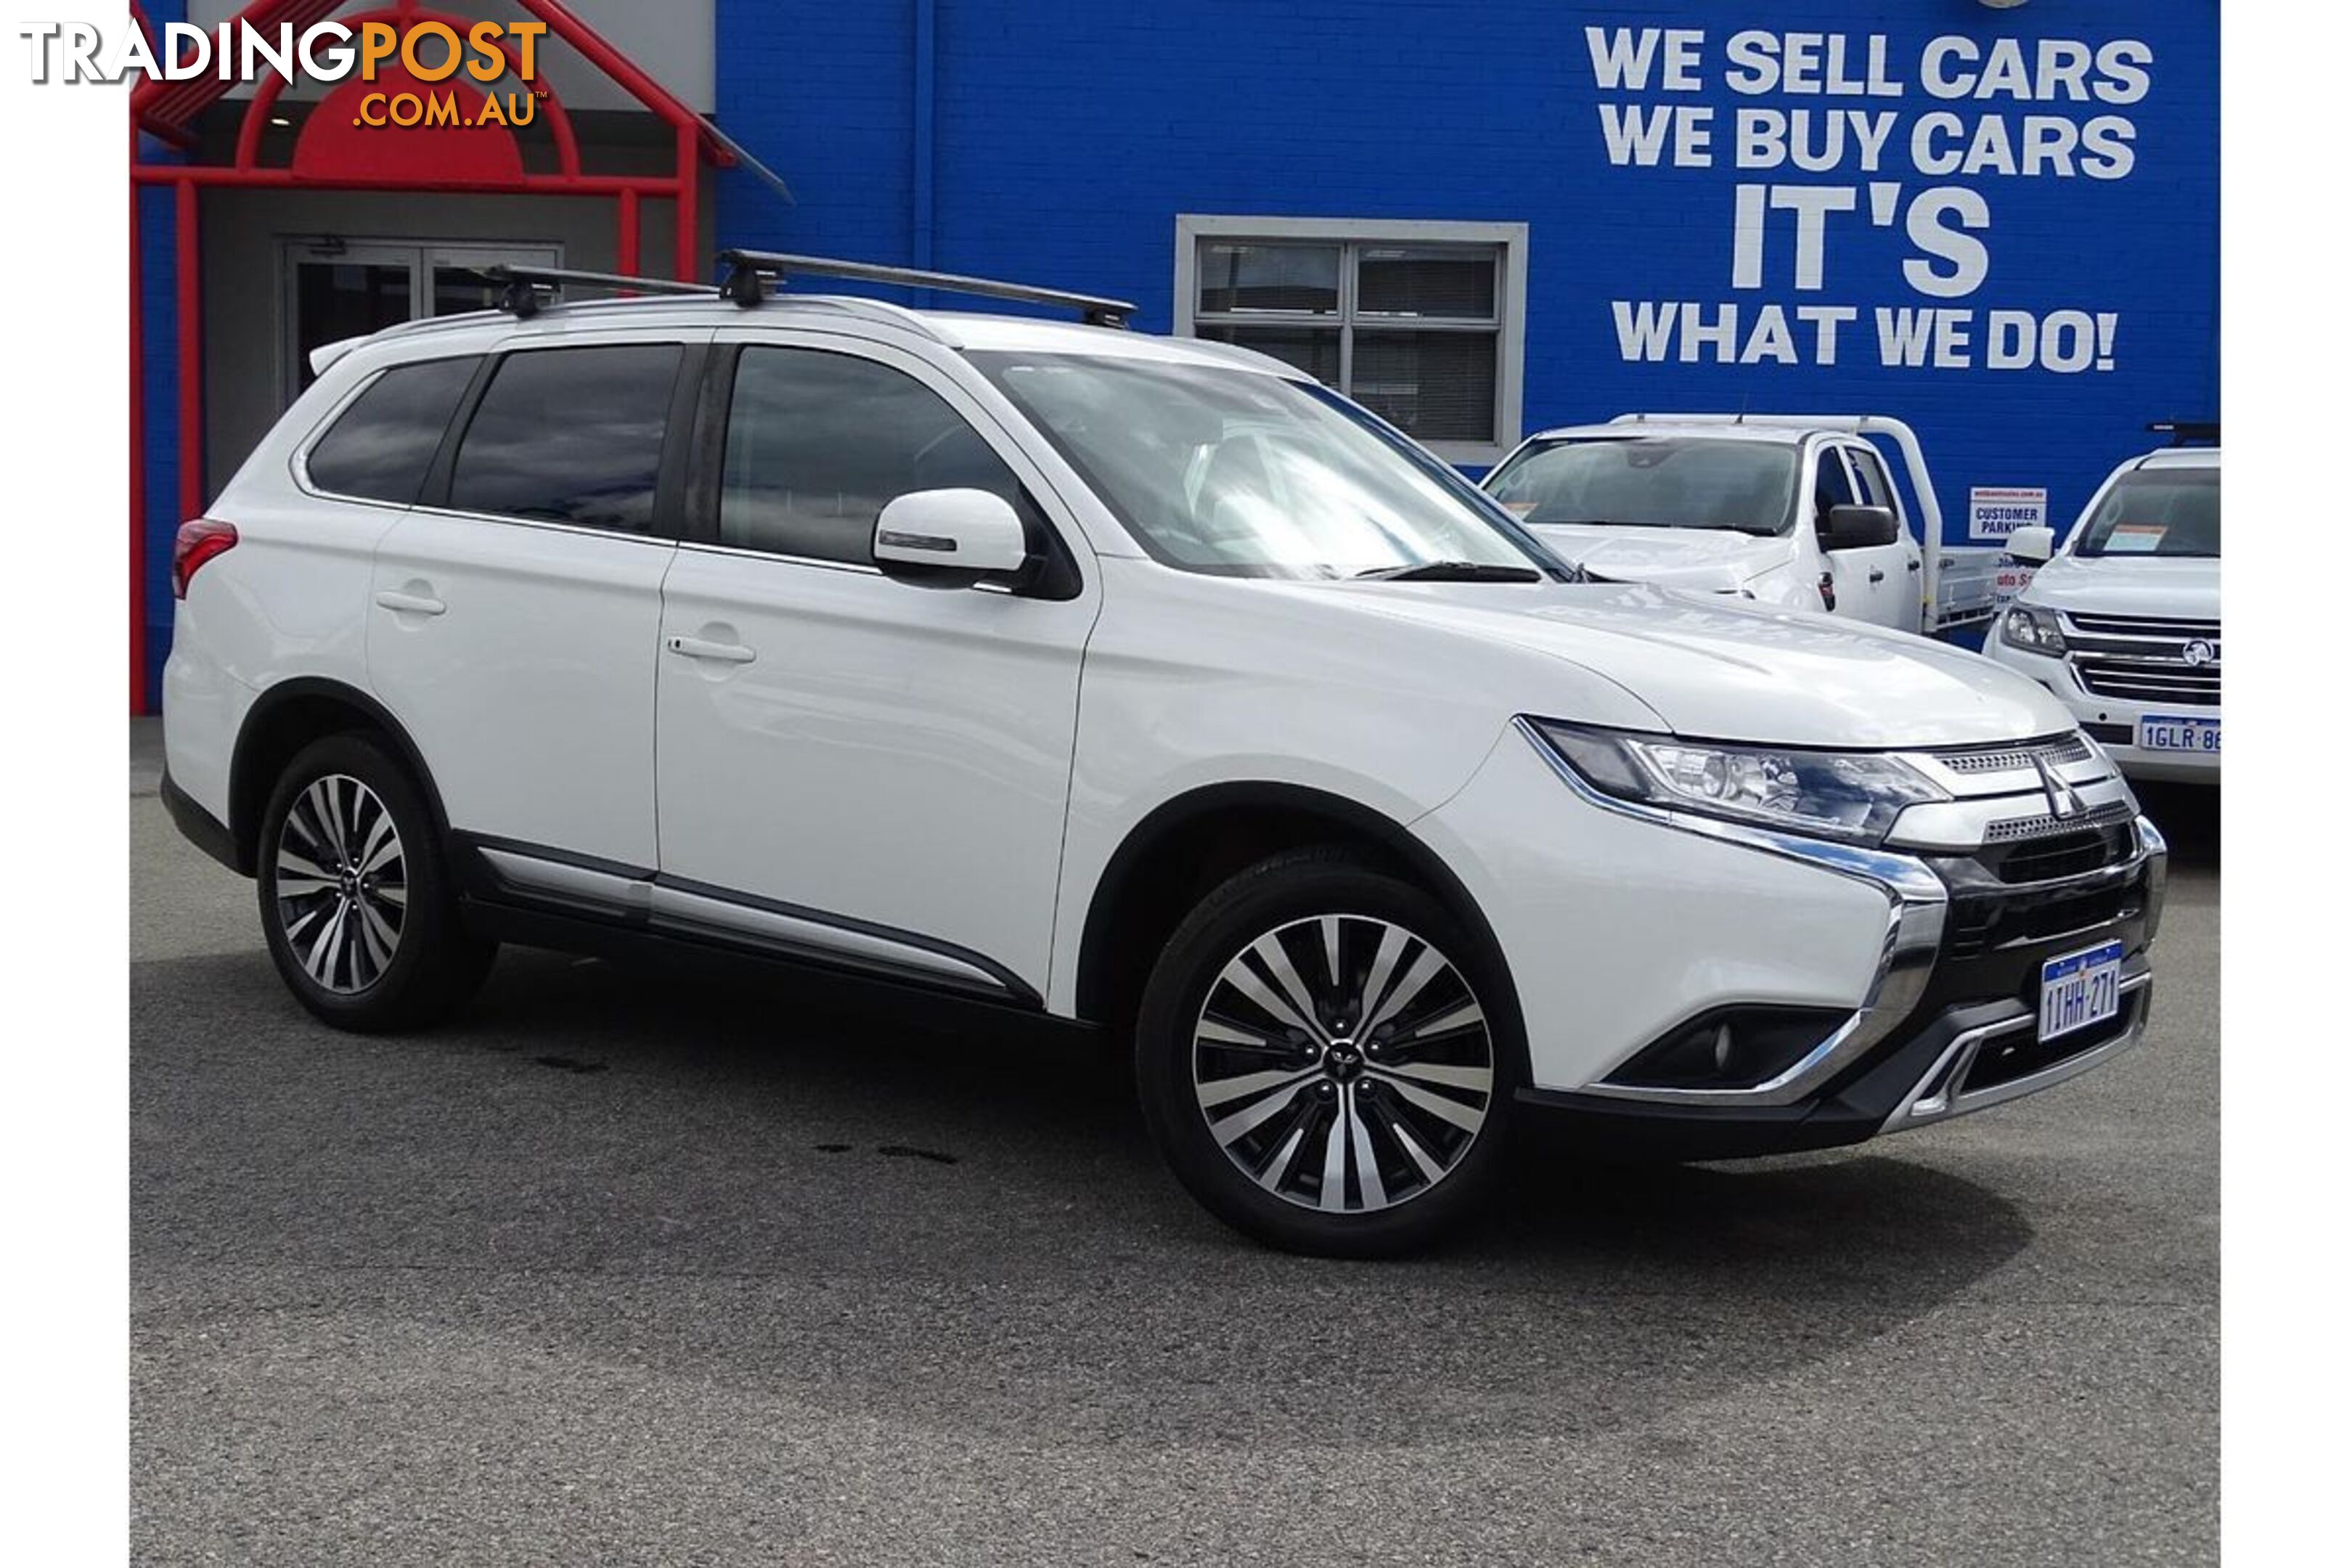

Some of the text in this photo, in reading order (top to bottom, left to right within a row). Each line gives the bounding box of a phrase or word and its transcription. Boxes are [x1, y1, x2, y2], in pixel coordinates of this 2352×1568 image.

[1585, 27, 2152, 103] WE SELL CARS
[1599, 105, 2135, 179] WE BUY CARS
[1733, 182, 1989, 297] IT'S
[1612, 302, 2118, 372] WHAT WE DO!
[1976, 507, 2038, 520] CUSTOMER
[1981, 521, 2033, 534] PARKI
